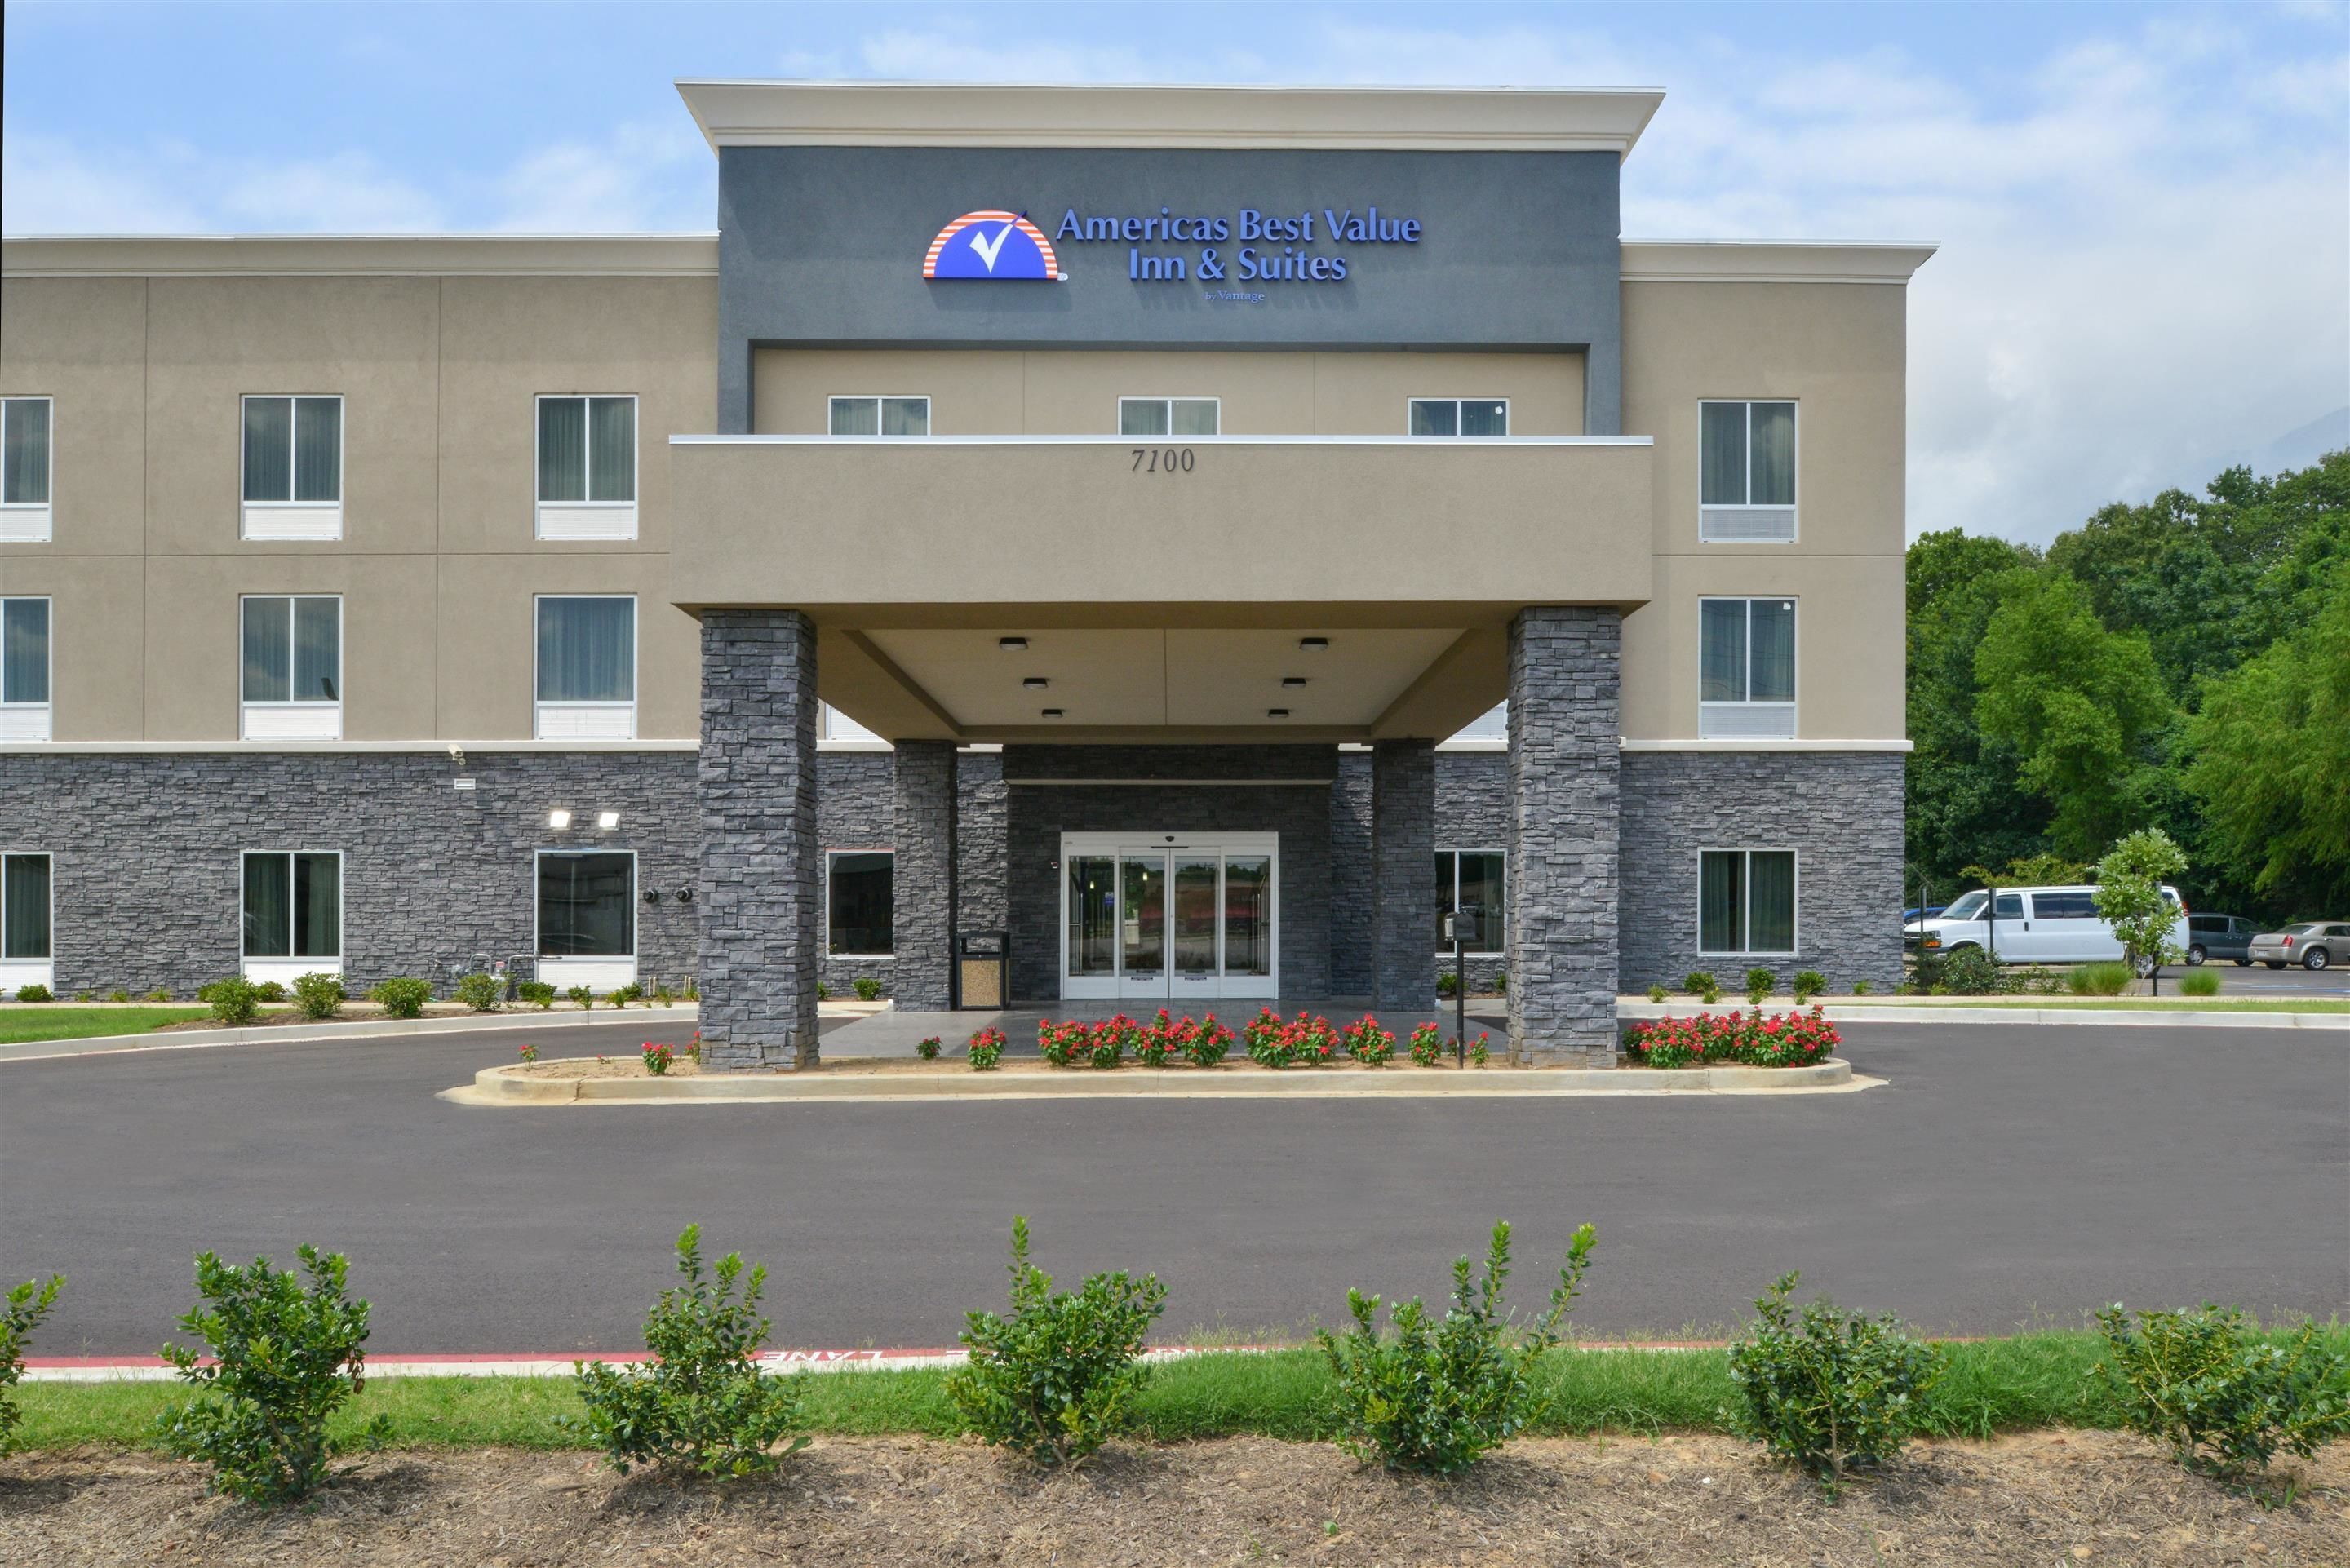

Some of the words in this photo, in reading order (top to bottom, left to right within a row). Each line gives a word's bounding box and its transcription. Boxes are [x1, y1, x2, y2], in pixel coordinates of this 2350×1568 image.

[1056, 206, 1229, 241] Americas
[1239, 208, 1315, 241] Best
[1324, 206, 1421, 242] Value
[1129, 248, 1185, 280] Inn
[1196, 247, 1226, 280] &
[1238, 246, 1346, 281] Suites
[1205, 291, 1217, 302] by
[1217, 290, 1266, 303] Vantage
[1131, 449, 1195, 472] 7100
[762, 1350, 883, 1362] LANE
